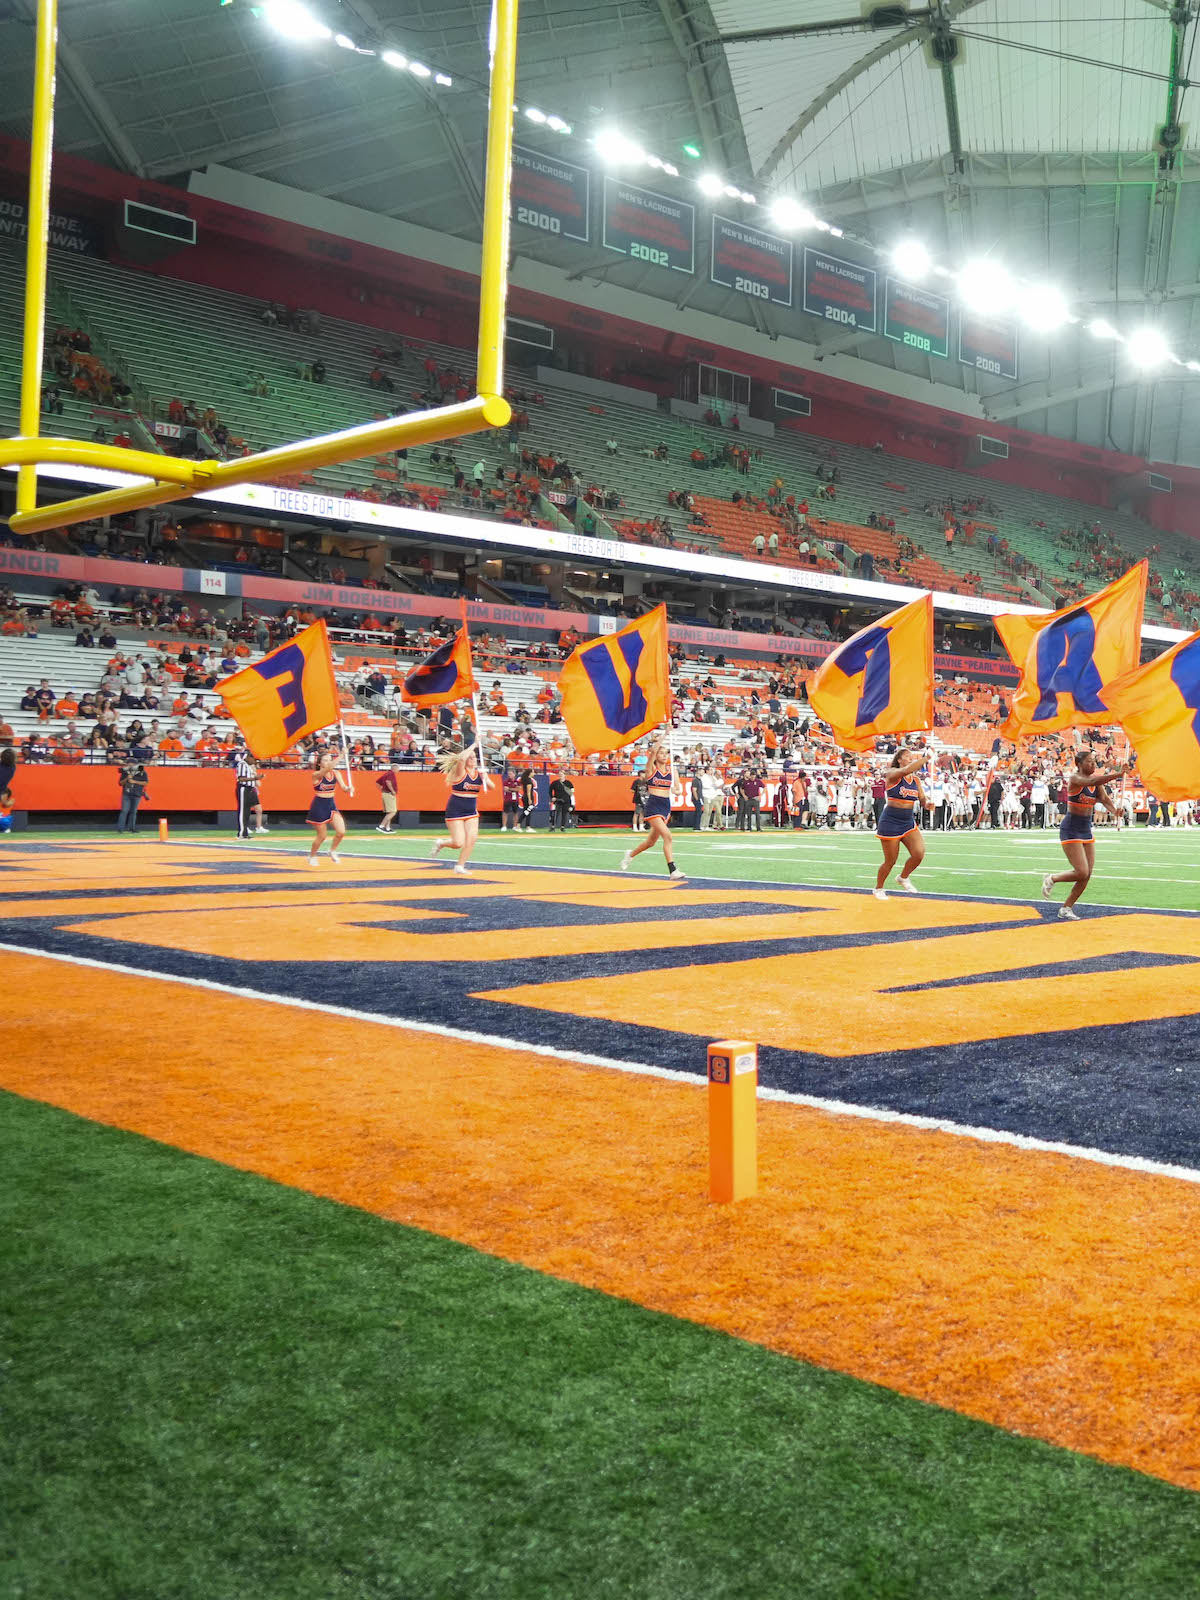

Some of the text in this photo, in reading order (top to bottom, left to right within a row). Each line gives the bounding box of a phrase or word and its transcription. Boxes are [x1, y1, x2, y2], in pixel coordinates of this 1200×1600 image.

[511, 153, 574, 182] EN'S LACROSSE
[618, 191, 681, 219] MEN'S LACROSSE
[517, 206, 561, 234] 2000
[721, 227, 785, 255] MEN'S BASKETBALL
[630, 242, 669, 267] 2002
[815, 260, 865, 283] MEN'S LACROSSE
[735, 276, 769, 299] 2003
[825, 305, 856, 327] 2004
[903, 331, 931, 352] 2008
[975, 356, 1001, 375] 2009
[156, 423, 180, 438] 317
[272, 490, 309, 512] TREES
[312, 496, 334, 516] FOR
[549, 492, 567, 505] 318
[567, 535, 594, 554] TREES
[596, 540, 612, 557] FOR
[204, 577, 222, 589] 114
[302, 586, 412, 610] JIM BOEHEIM
[466, 605, 546, 625] JIM BROWN
[668, 628, 740, 645] ERNIE DAVIS
[767, 638, 836, 655] FLOYD LITTLE
[934, 656, 962, 669] WAYNE
[711, 1056, 728, 1082] S
